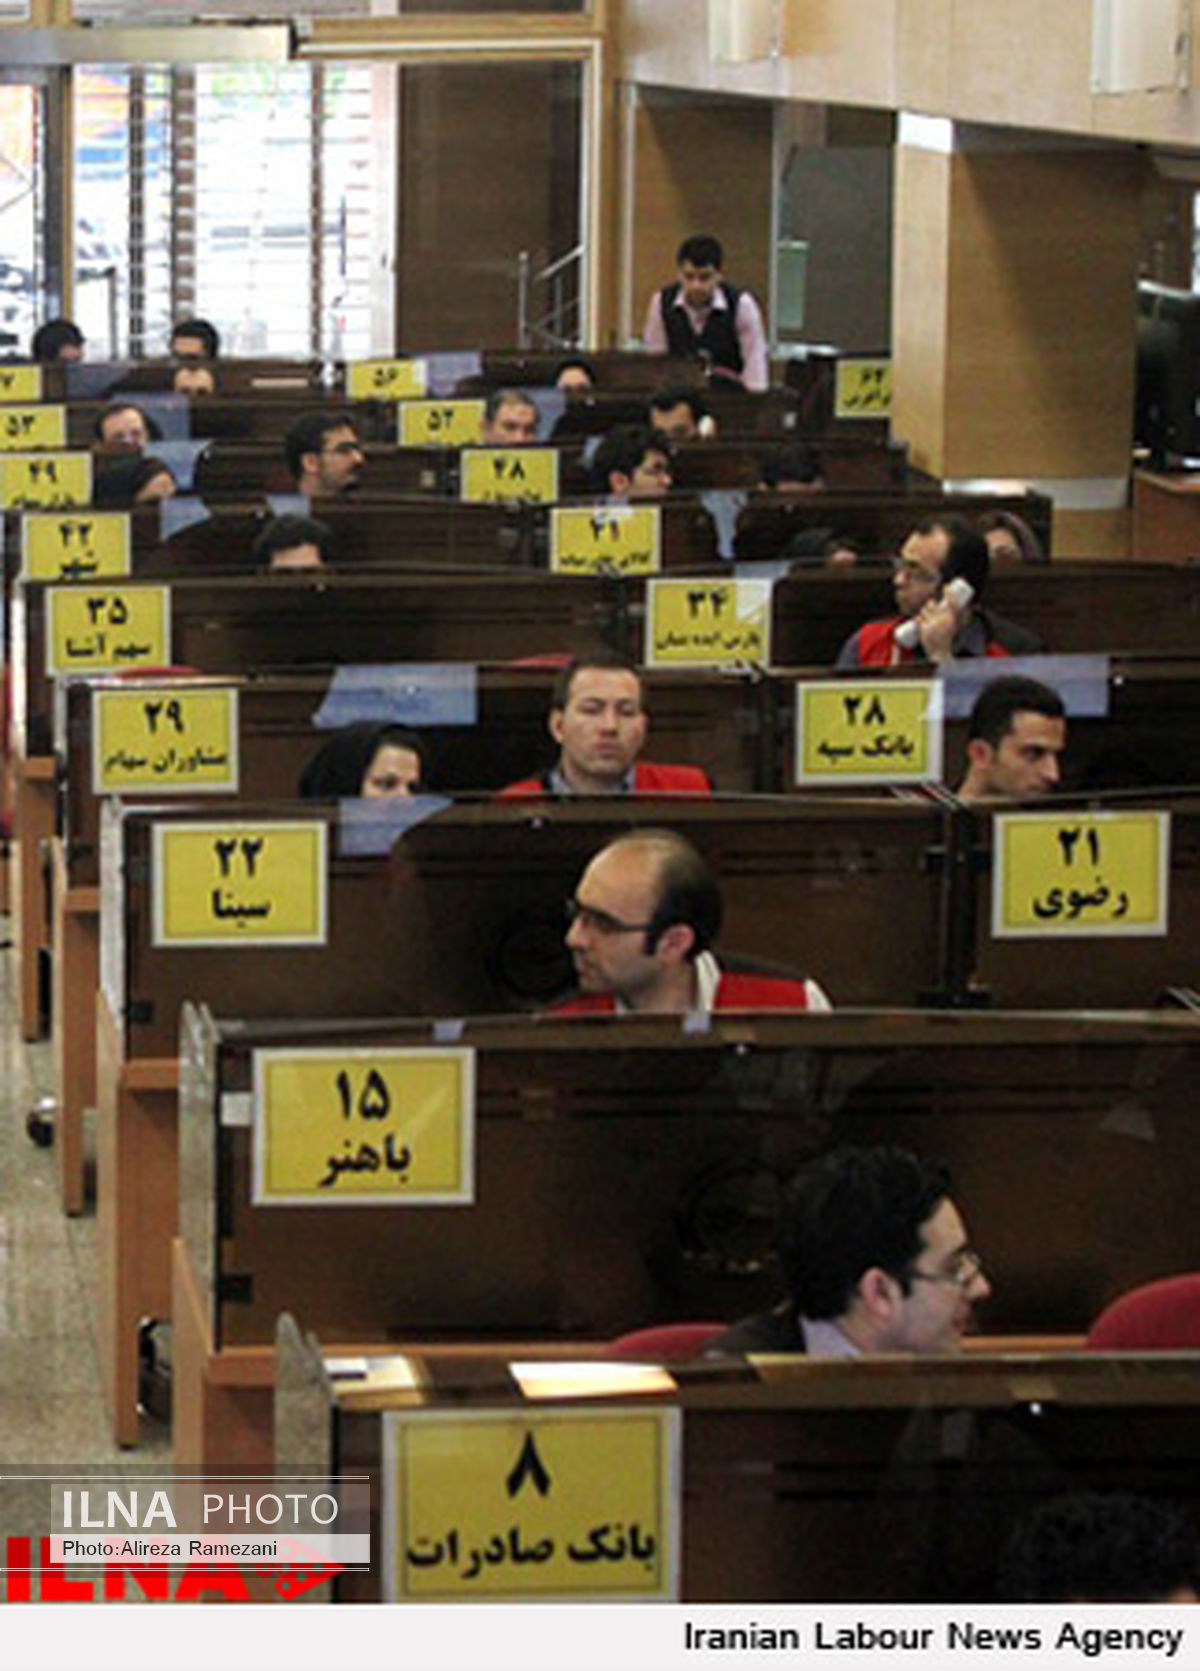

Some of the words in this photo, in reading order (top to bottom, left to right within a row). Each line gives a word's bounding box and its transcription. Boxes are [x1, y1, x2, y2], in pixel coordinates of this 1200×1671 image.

[87, 597, 129, 625] ۳۵
[687, 587, 728, 618] ۳۴
[144, 699, 185, 734] ۲۹
[843, 696, 886, 726] ۲۸
[817, 741, 854, 765] سپه
[862, 735, 914, 758] بانک
[214, 838, 263, 878] ۲۲
[1058, 827, 1100, 867] ۲۱
[212, 888, 271, 928] سینا
[1032, 876, 1129, 919] رضوی
[335, 1068, 391, 1121] ۱۵
[317, 1133, 413, 1188] باهنر
[506, 1430, 551, 1497] ۸
[406, 1528, 555, 1579] صادرات
[567, 1522, 655, 1571] بانک
